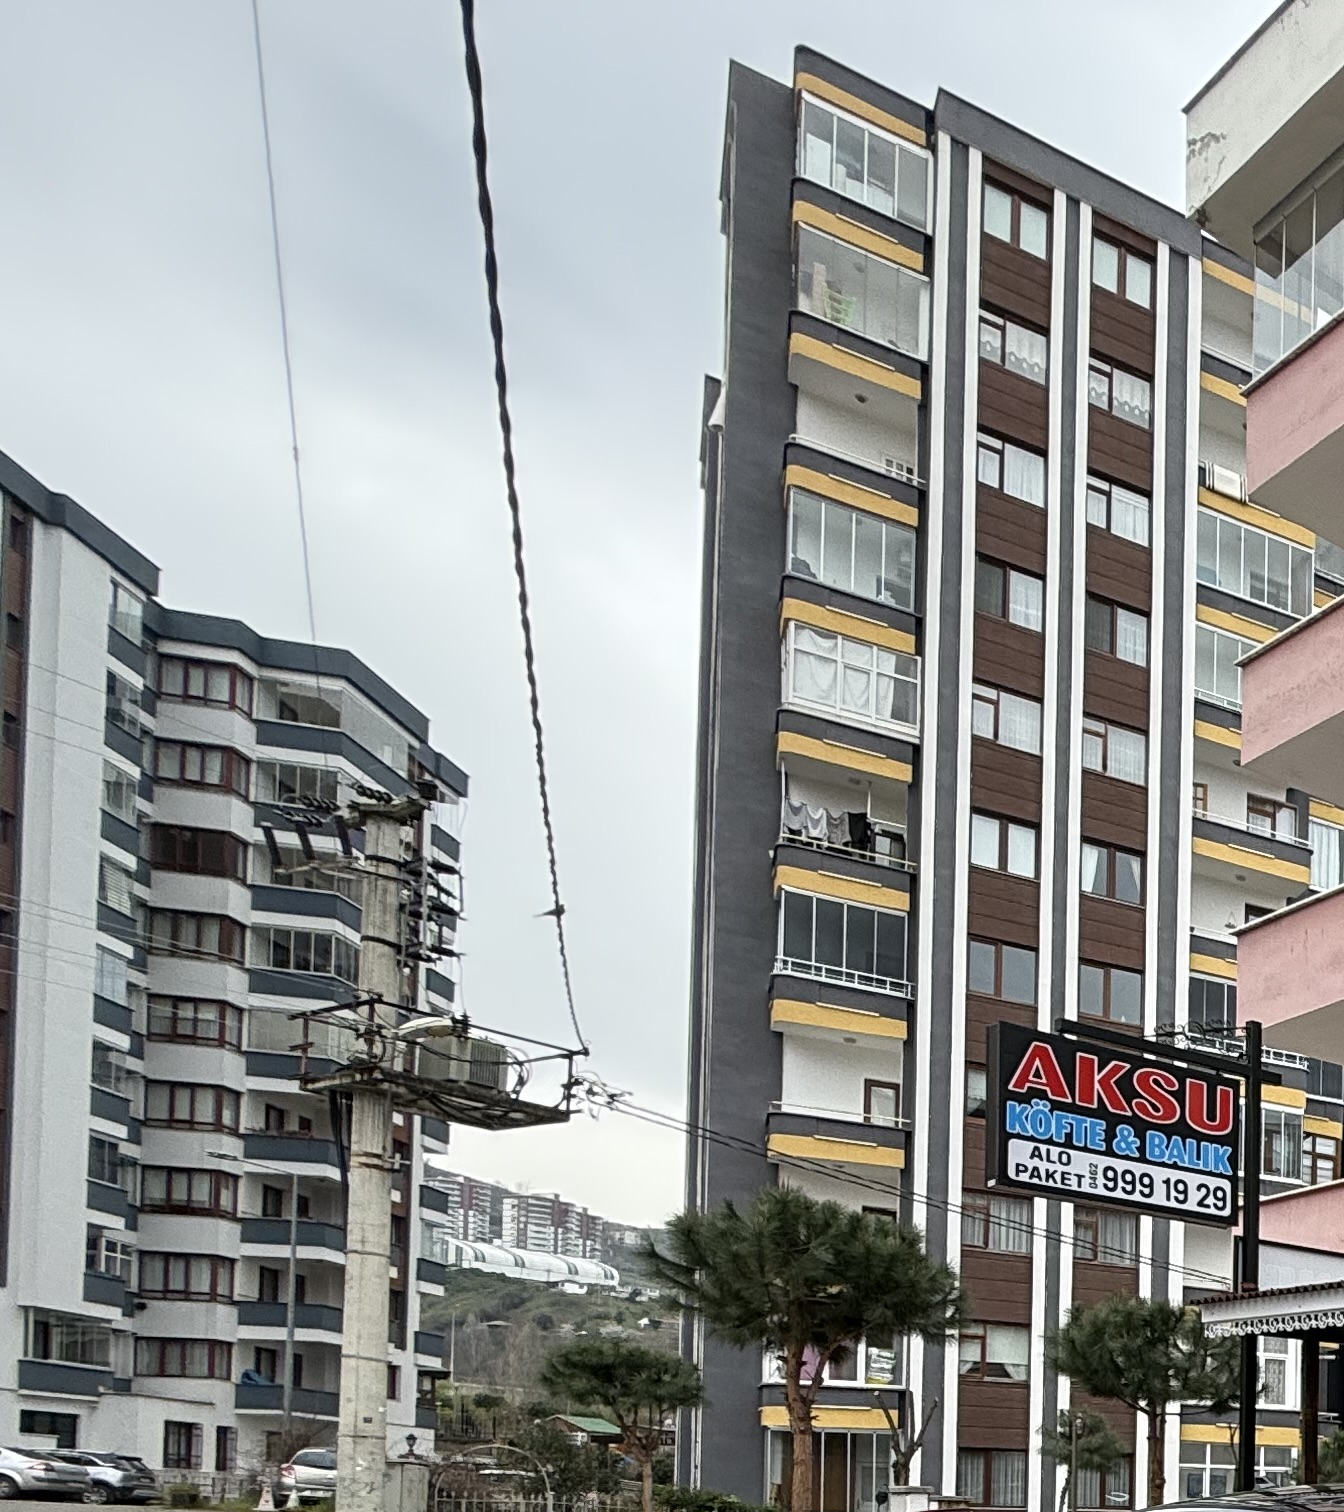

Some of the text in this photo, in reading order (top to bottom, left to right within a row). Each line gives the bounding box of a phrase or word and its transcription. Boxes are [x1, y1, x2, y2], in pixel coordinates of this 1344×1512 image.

[1007, 1041, 1234, 1135] AKSU
[1006, 1098, 1233, 1175] KÖFTE & BALIK
[1029, 1146, 1071, 1167] ALO
[1015, 1162, 1086, 1190] PAKET
[1088, 1162, 1227, 1211] 0462 999 19 29
